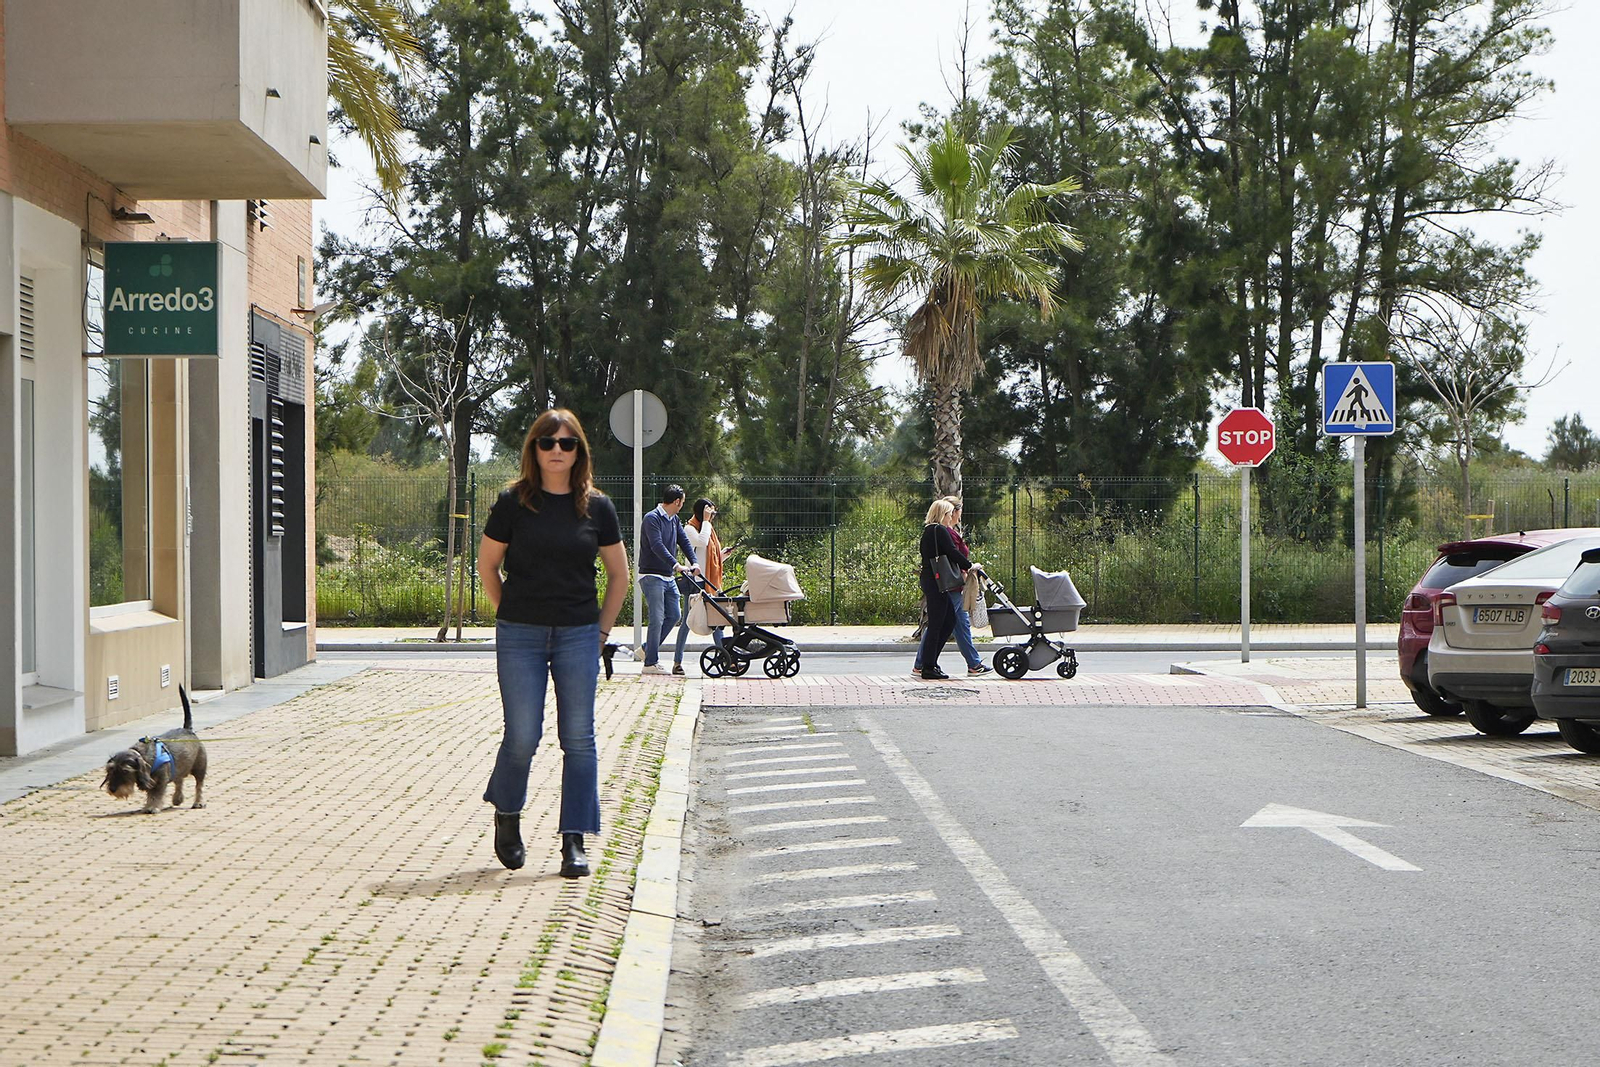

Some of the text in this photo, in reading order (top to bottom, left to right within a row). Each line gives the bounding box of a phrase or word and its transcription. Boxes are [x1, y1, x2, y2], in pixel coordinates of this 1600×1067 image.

[108, 287, 214, 312] Arredo3
[128, 326, 192, 335] CUCINE
[1220, 430, 1271, 445] STOP
[1478, 609, 1525, 623] 6507 HJB
[1571, 670, 1596, 684] 2039
